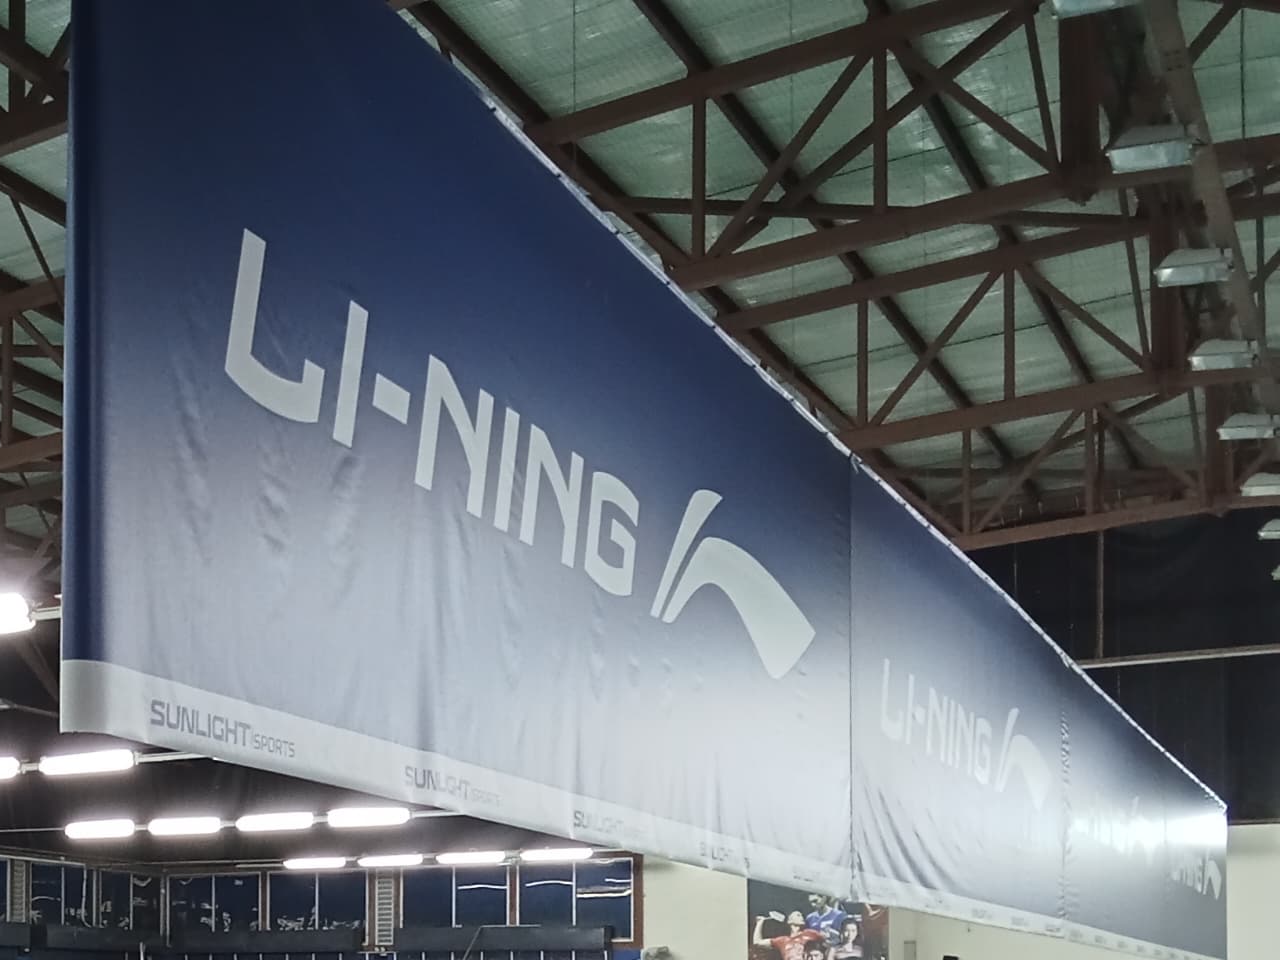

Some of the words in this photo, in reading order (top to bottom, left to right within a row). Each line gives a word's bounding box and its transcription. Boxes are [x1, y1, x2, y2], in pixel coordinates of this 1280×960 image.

[225, 228, 639, 597] LI-NING
[150, 699, 251, 747] SUNLIGHT
[253, 733, 296, 758] SPORTS
[880, 657, 992, 785] LI-NING
